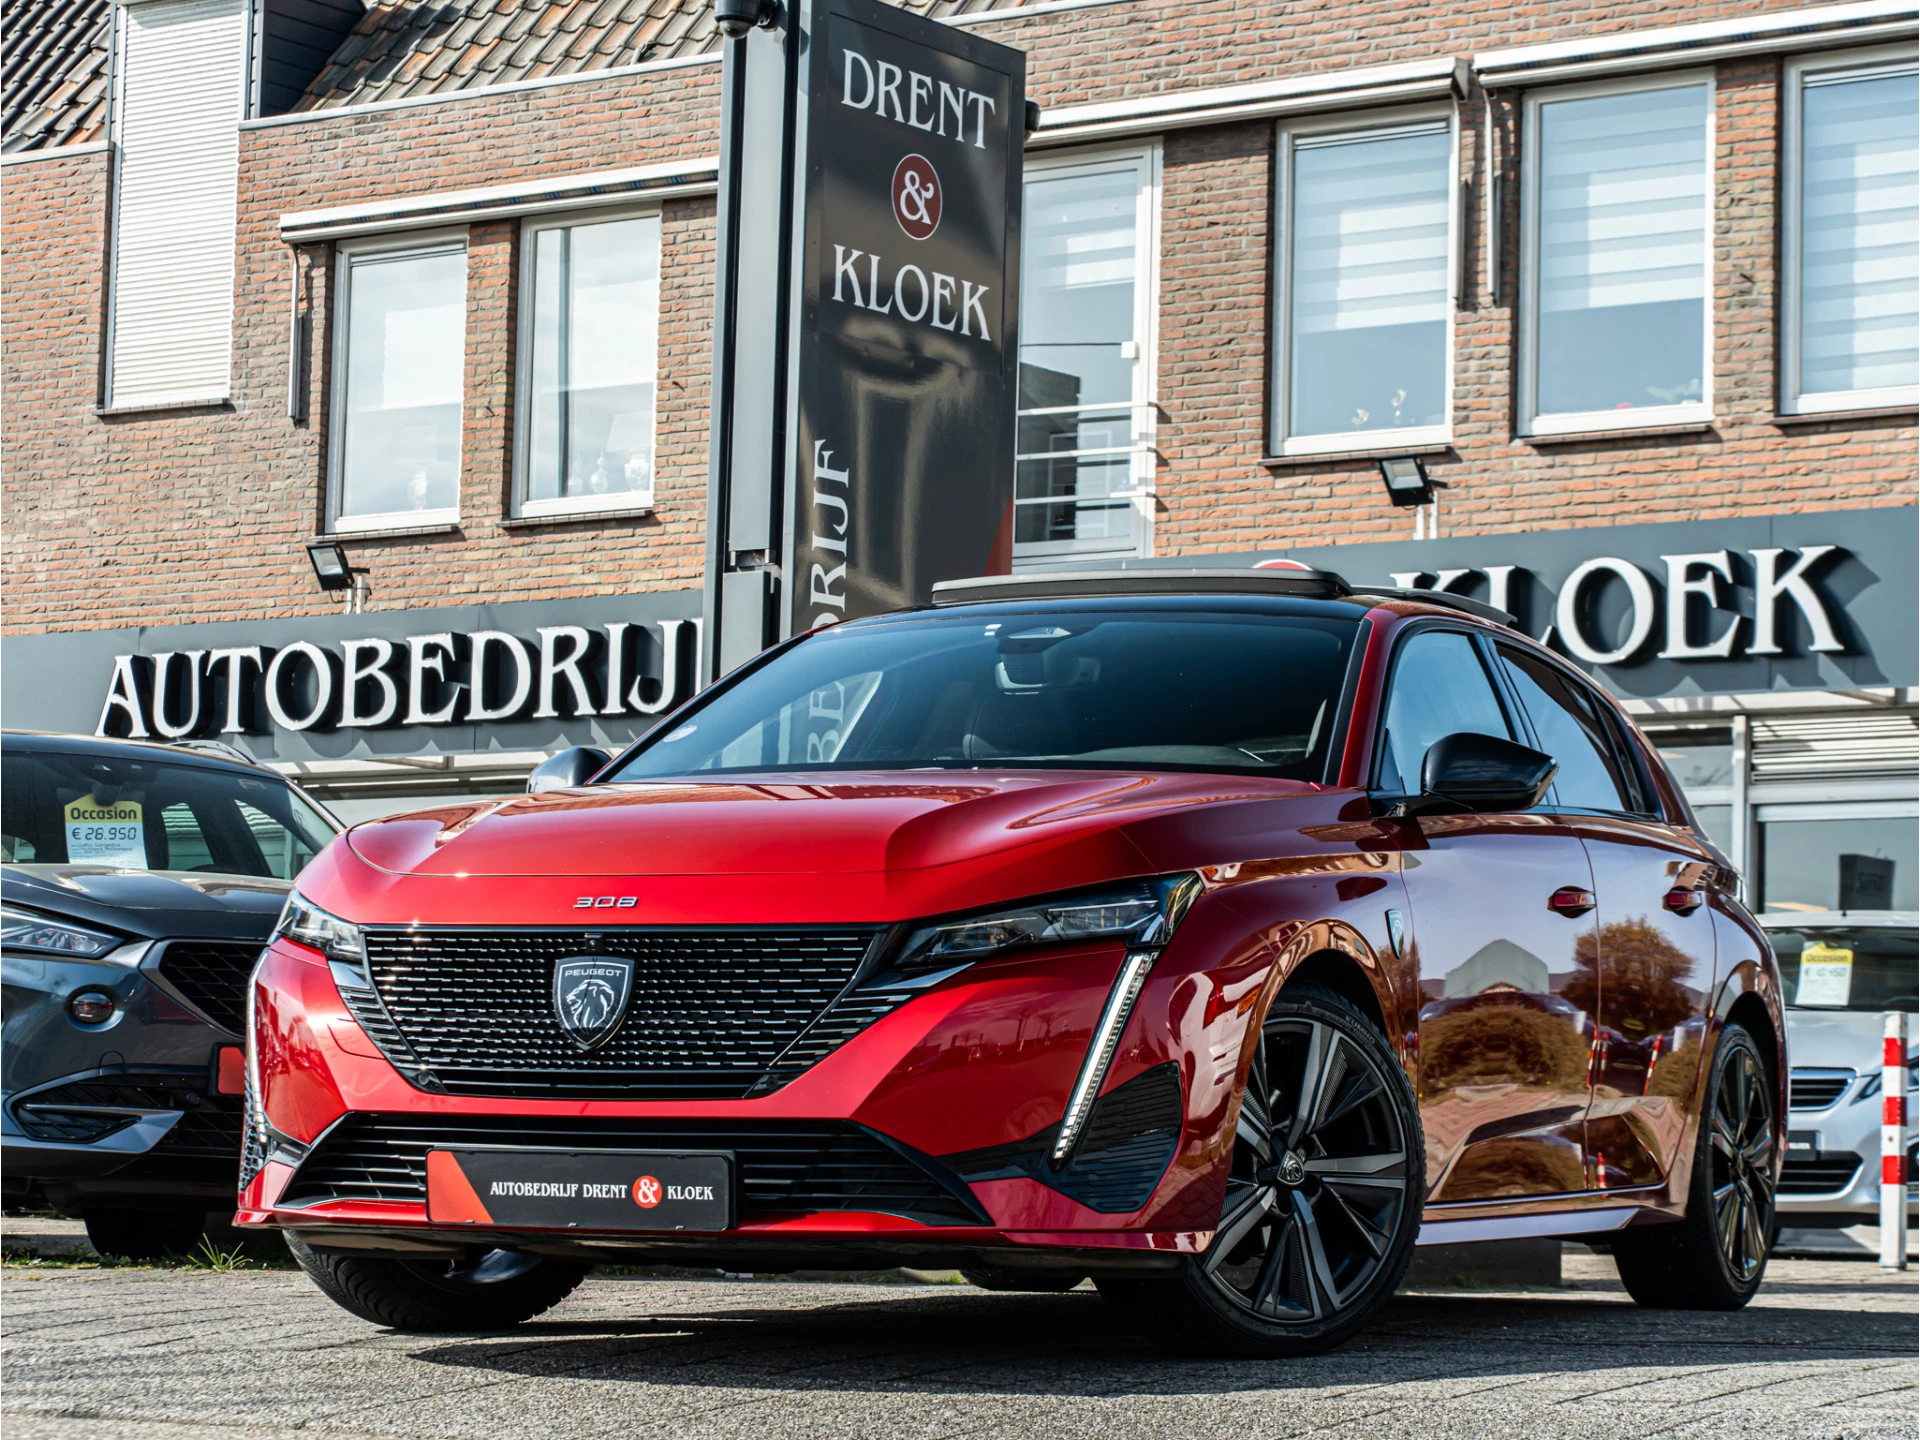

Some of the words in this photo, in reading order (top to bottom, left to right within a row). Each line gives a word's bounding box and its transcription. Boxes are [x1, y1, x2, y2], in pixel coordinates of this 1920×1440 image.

[841, 48, 996, 149] DRENT
[900, 170, 934, 225] &
[832, 244, 991, 341] KLOEK
[1389, 545, 1845, 664] LOEK
[95, 617, 704, 738] AUTOBEDRIJ
[70, 807, 137, 820] Occasion
[72, 827, 82, 840] €
[85, 827, 137, 840] 26.950
[573, 896, 639, 908] 308
[565, 968, 622, 977] PEUGEOT
[1344, 1014, 1376, 1045] KUMHO
[490, 1181, 579, 1198] AUTOBEDRIJF
[582, 1183, 628, 1199] DRENT
[638, 1178, 659, 1204] &
[667, 1186, 714, 1200] KLOEK
